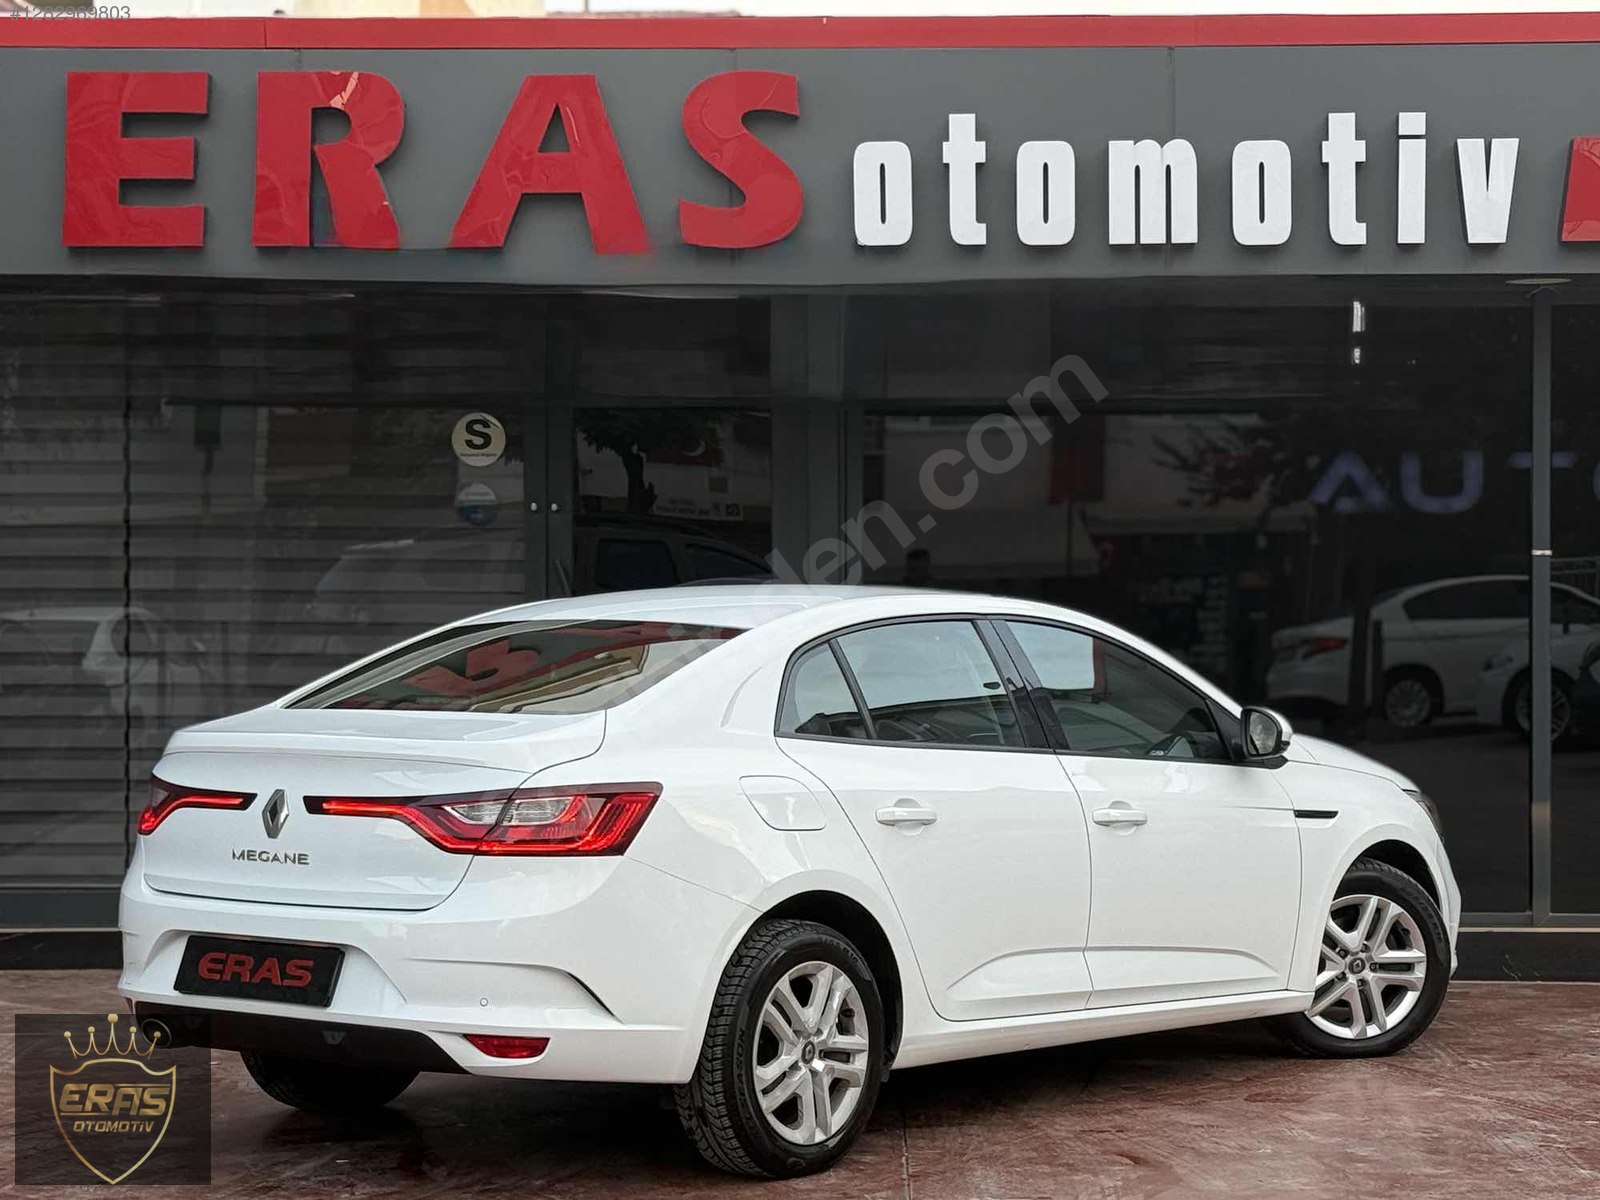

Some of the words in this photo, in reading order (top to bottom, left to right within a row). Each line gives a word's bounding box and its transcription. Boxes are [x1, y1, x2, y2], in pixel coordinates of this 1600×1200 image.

[62, 70, 804, 254] ERAS
[853, 112, 1520, 247] otomotiv
[464, 418, 492, 450] S
[1307, 451, 1600, 513] AU
[232, 849, 310, 865] MEGANE
[198, 953, 314, 987] ERAS
